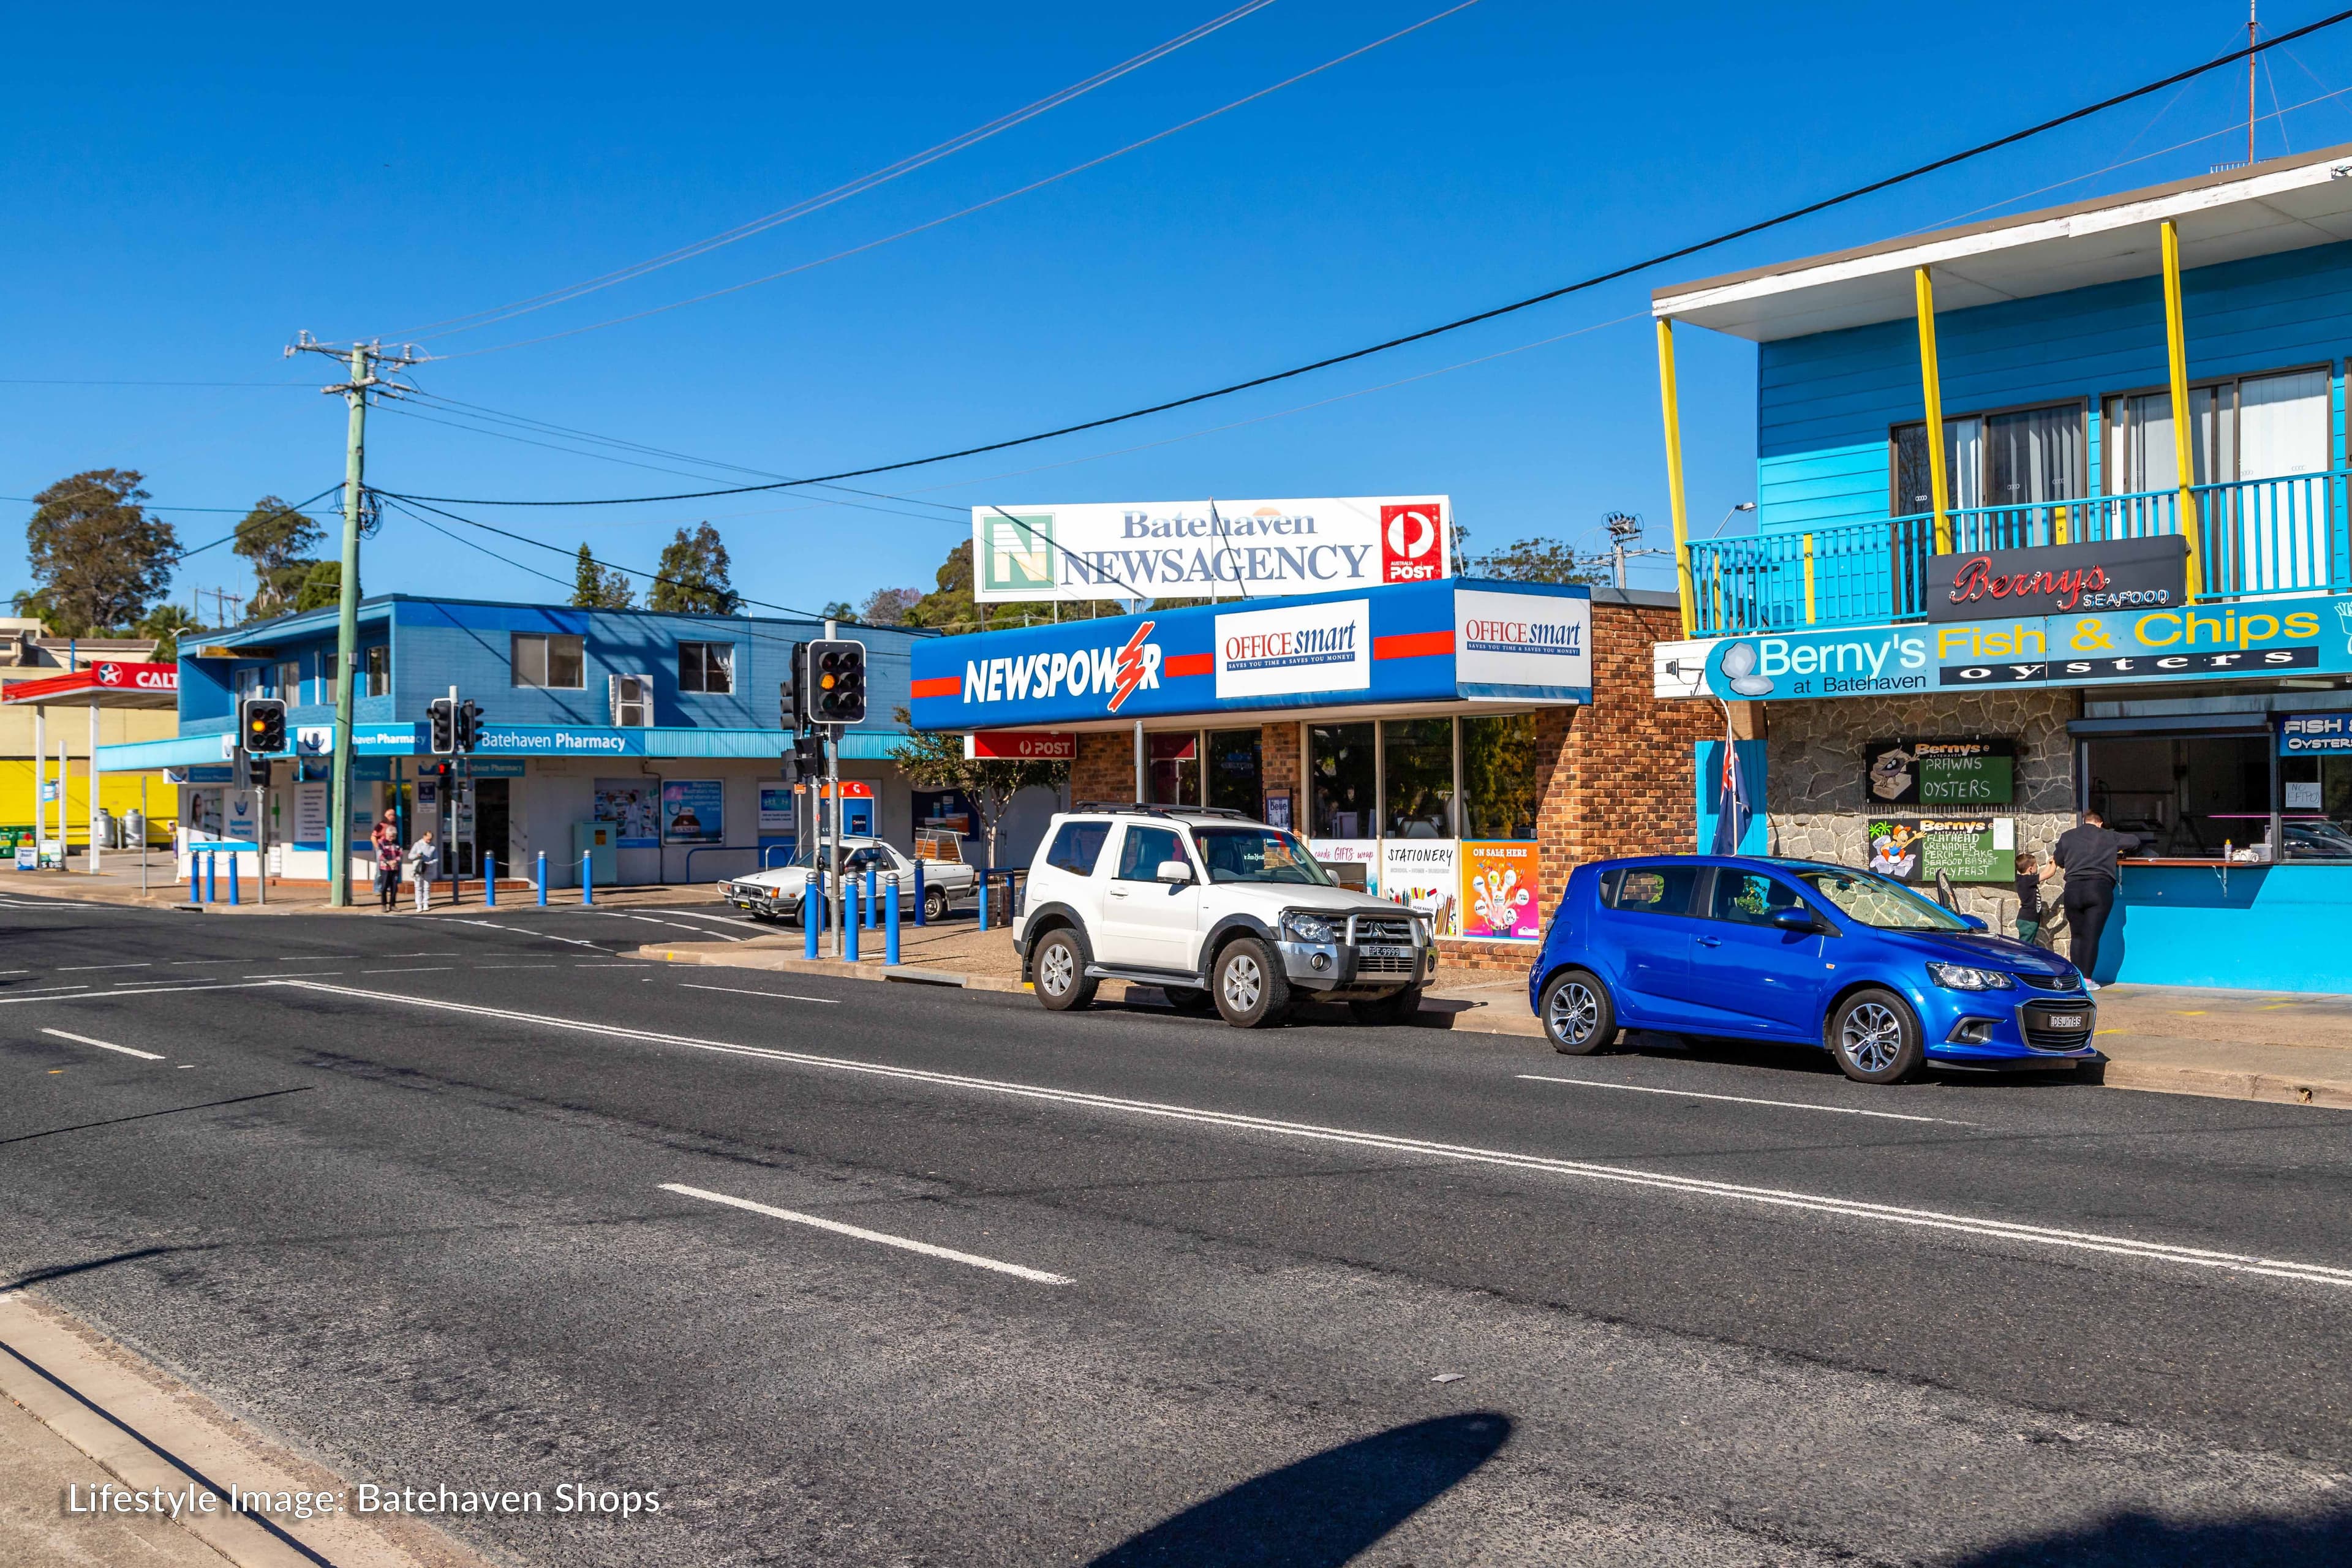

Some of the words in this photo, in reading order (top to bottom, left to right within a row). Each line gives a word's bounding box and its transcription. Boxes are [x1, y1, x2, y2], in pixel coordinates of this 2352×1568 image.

[1120, 509, 1318, 539] Batehaven
[1061, 543, 1373, 585] NEWSAGENCY
[1390, 565, 1434, 579] POST
[1948, 556, 2110, 612] Bernys
[2083, 589, 2169, 608] SEAFOOD
[1938, 625, 2046, 659] Fish
[2070, 618, 2114, 651] &
[2135, 609, 2320, 649] Chips
[1760, 633, 1926, 680] Berny's
[963, 620, 1161, 713] NEWSPOWER
[1960, 651, 2293, 680] oysters
[136, 671, 178, 688] CALT
[1793, 679, 1811, 693] at
[1823, 674, 1926, 692] Batehaven
[2284, 718, 2342, 734] FISH
[377, 733, 426, 745] Pharmacy
[481, 732, 551, 747] Batehaven
[556, 733, 626, 752] Pharmacy
[2288, 738, 2352, 749] OYSTER
[1035, 742, 1071, 755] POST
[1915, 744, 1980, 756] Bernys
[1926, 758, 1982, 771] PRAWNS
[1924, 779, 1990, 797] OYSTERS
[1920, 820, 1985, 833] Bernys
[1923, 842, 1977, 851] GRENADIER
[1927, 834, 1980, 843] FLATHEAD
[1314, 848, 1331, 859] cards
[1334, 846, 1355, 861] GIFTS
[1357, 850, 1374, 862] wrap
[1388, 848, 1454, 867] STATIONERY
[1473, 848, 1485, 857] ON
[1925, 850, 1954, 860] PERCH
[1962, 850, 1993, 858] FLAKE
[1966, 857, 1999, 865] BASKET
[1958, 865, 1989, 876] FEAST
